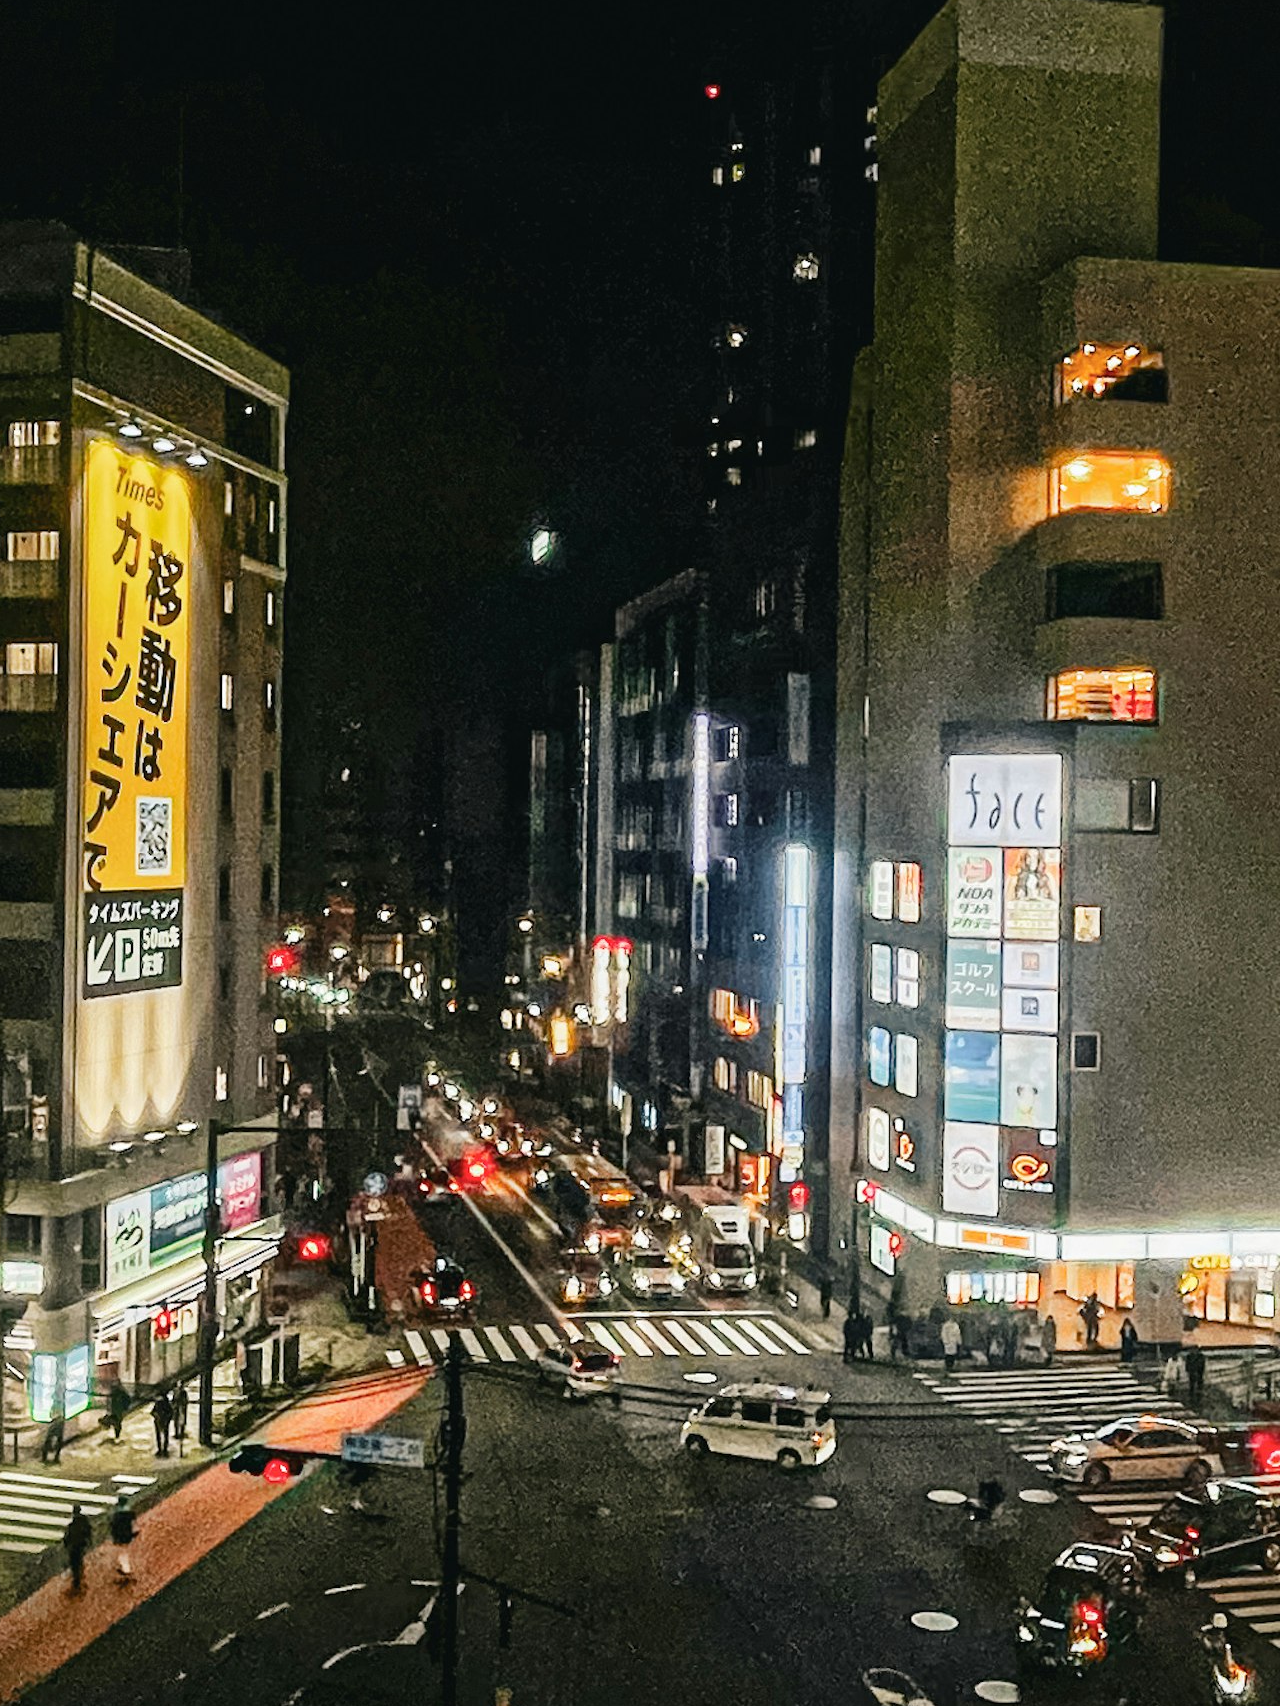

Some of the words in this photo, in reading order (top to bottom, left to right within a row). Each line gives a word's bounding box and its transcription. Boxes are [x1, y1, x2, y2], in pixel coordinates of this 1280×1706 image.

[117, 467, 167, 512] Times
[132, 537, 184, 783] 移動は
[84, 511, 141, 892] カーシェアで
[950, 981, 998, 998] スクール
[954, 962, 994, 979] ゴルフ
